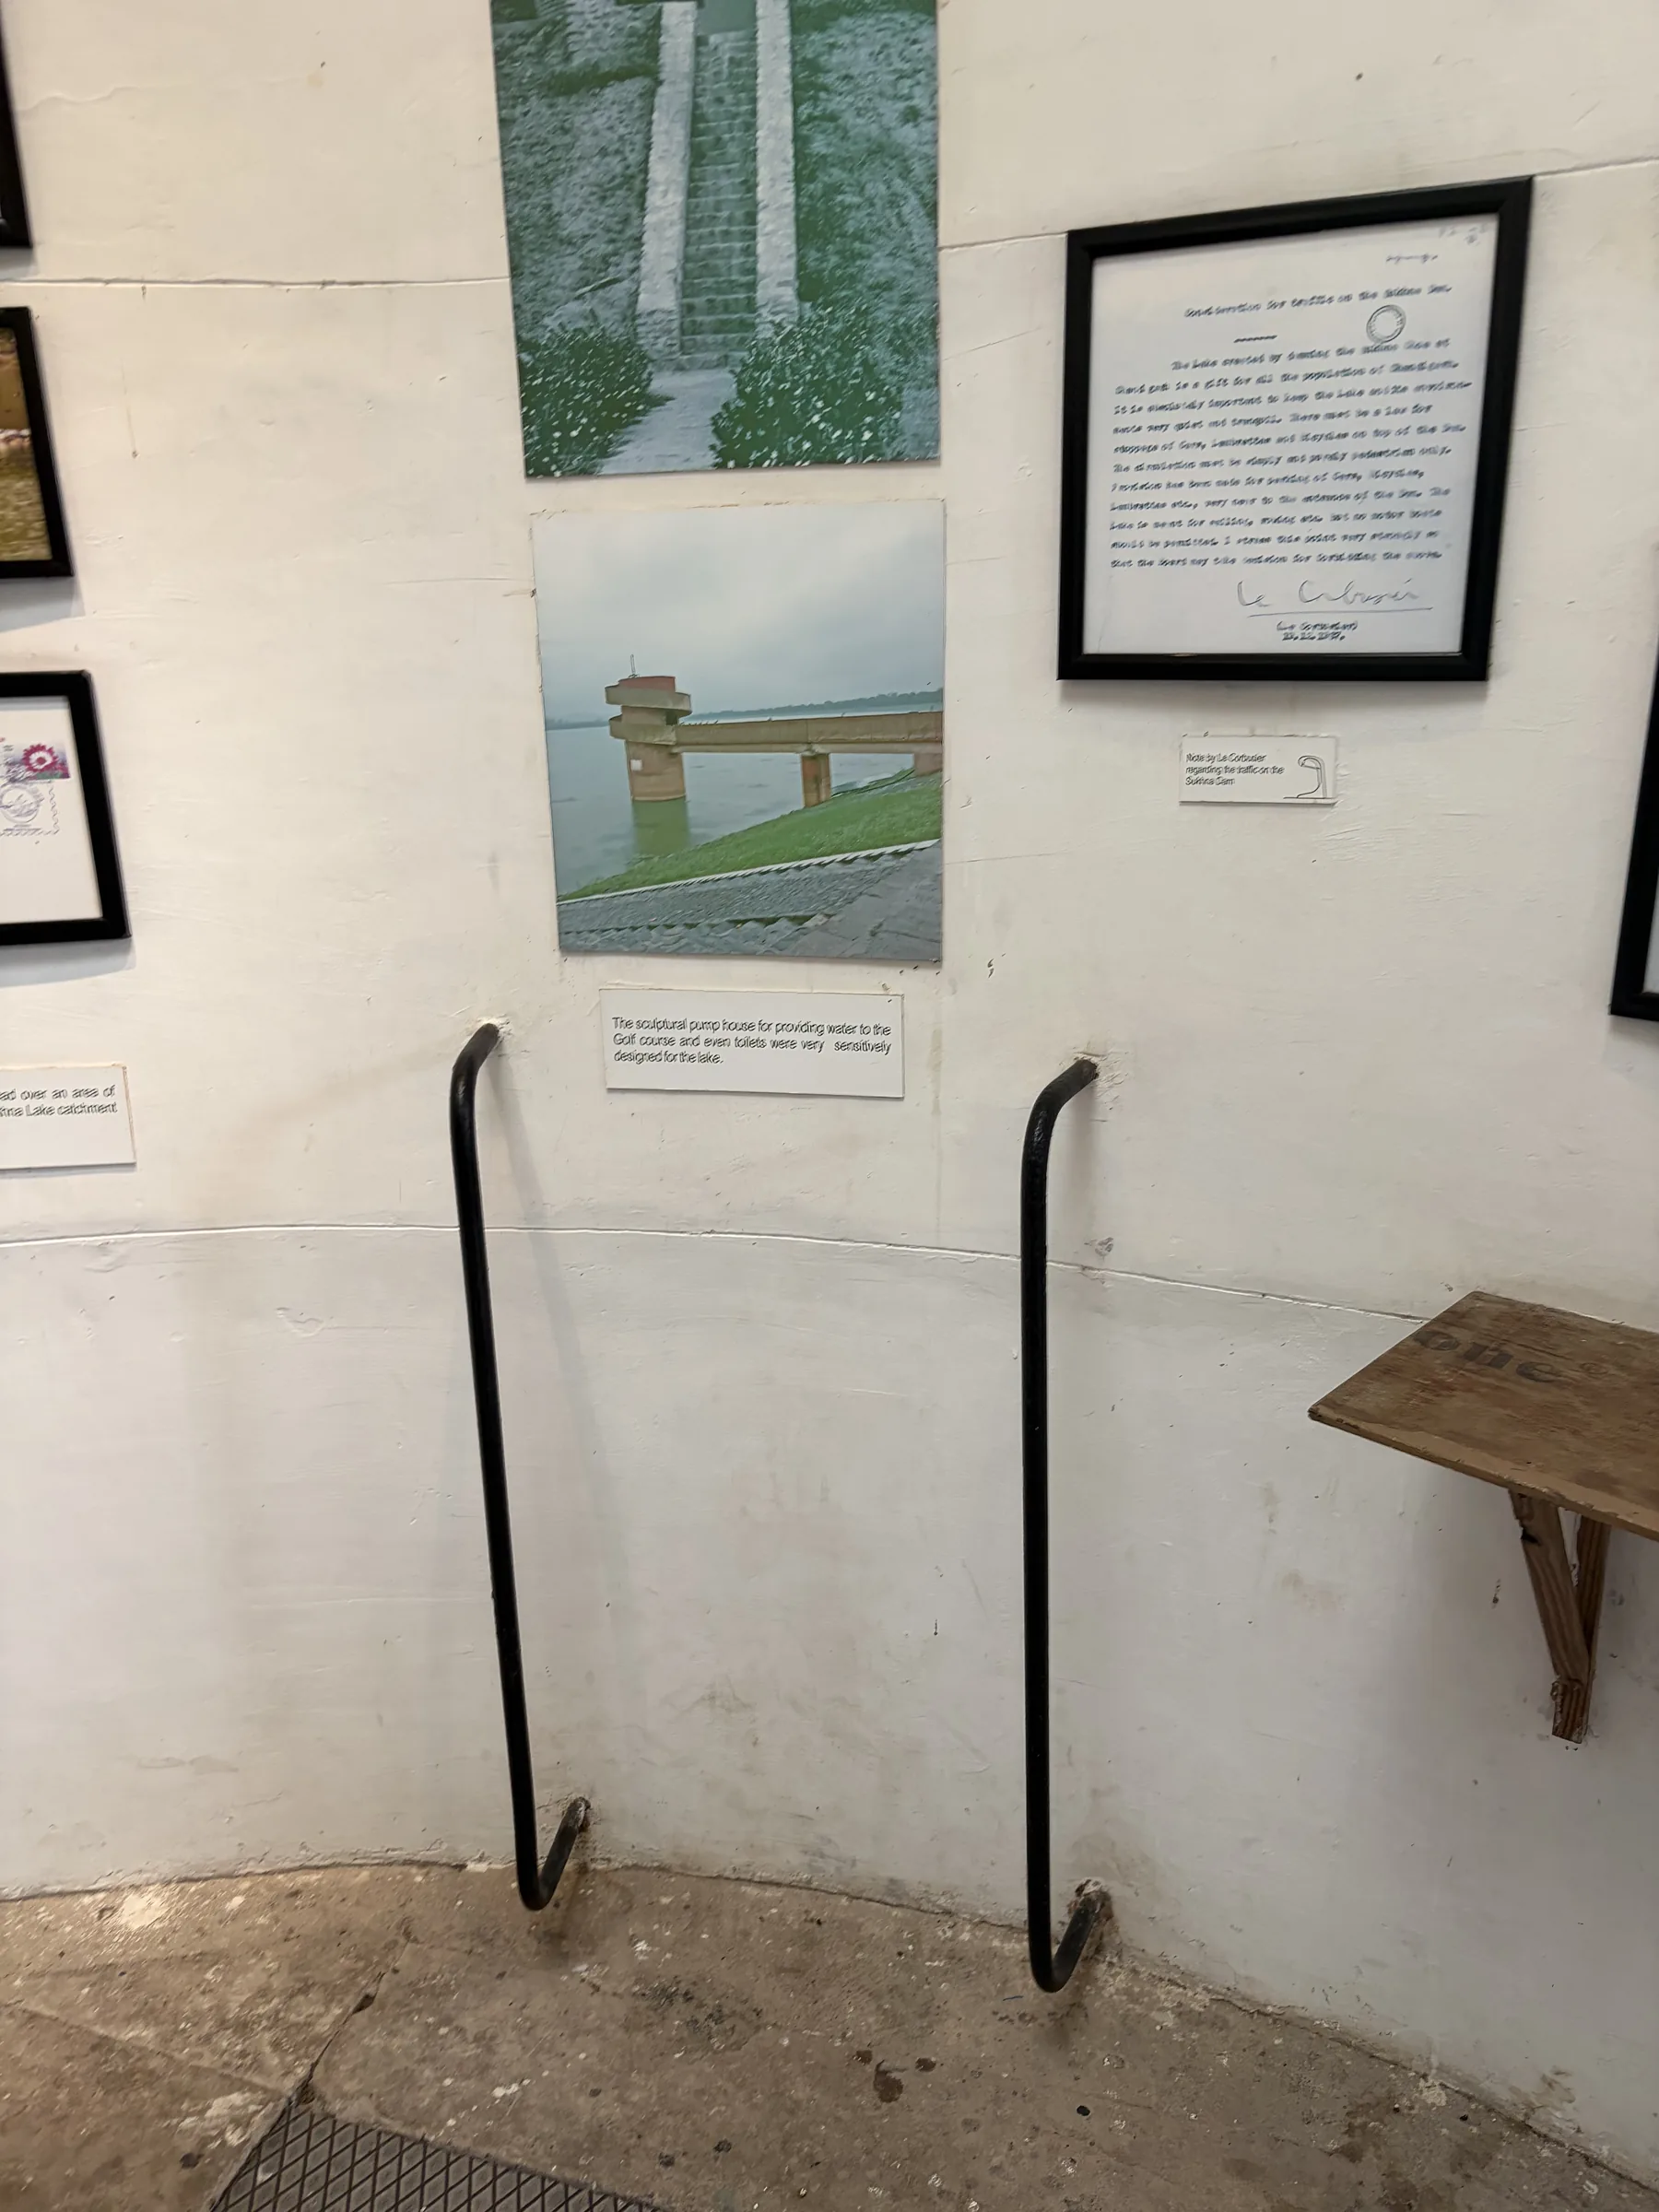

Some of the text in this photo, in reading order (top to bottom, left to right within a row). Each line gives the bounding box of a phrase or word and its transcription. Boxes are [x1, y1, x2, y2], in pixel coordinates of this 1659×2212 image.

[1186, 753, 1205, 763] Note
[1217, 753, 1228, 762] Le
[1185, 765, 1223, 776] regarding
[1224, 765, 1235, 774] the
[1270, 765, 1285, 774] the
[612, 1017, 891, 1037] The sculptural pump house for providing water to the
[613, 1032, 891, 1055] Golf course and even toilets were very sensitively
[614, 1050, 724, 1065] designed for the lake.
[20, 1089, 48, 1100] over
[52, 1088, 68, 1100] an
[72, 1088, 100, 1099] area
[102, 1084, 116, 1098] of
[25, 1104, 55, 1117] Lake
[57, 1101, 118, 1115] catchment
